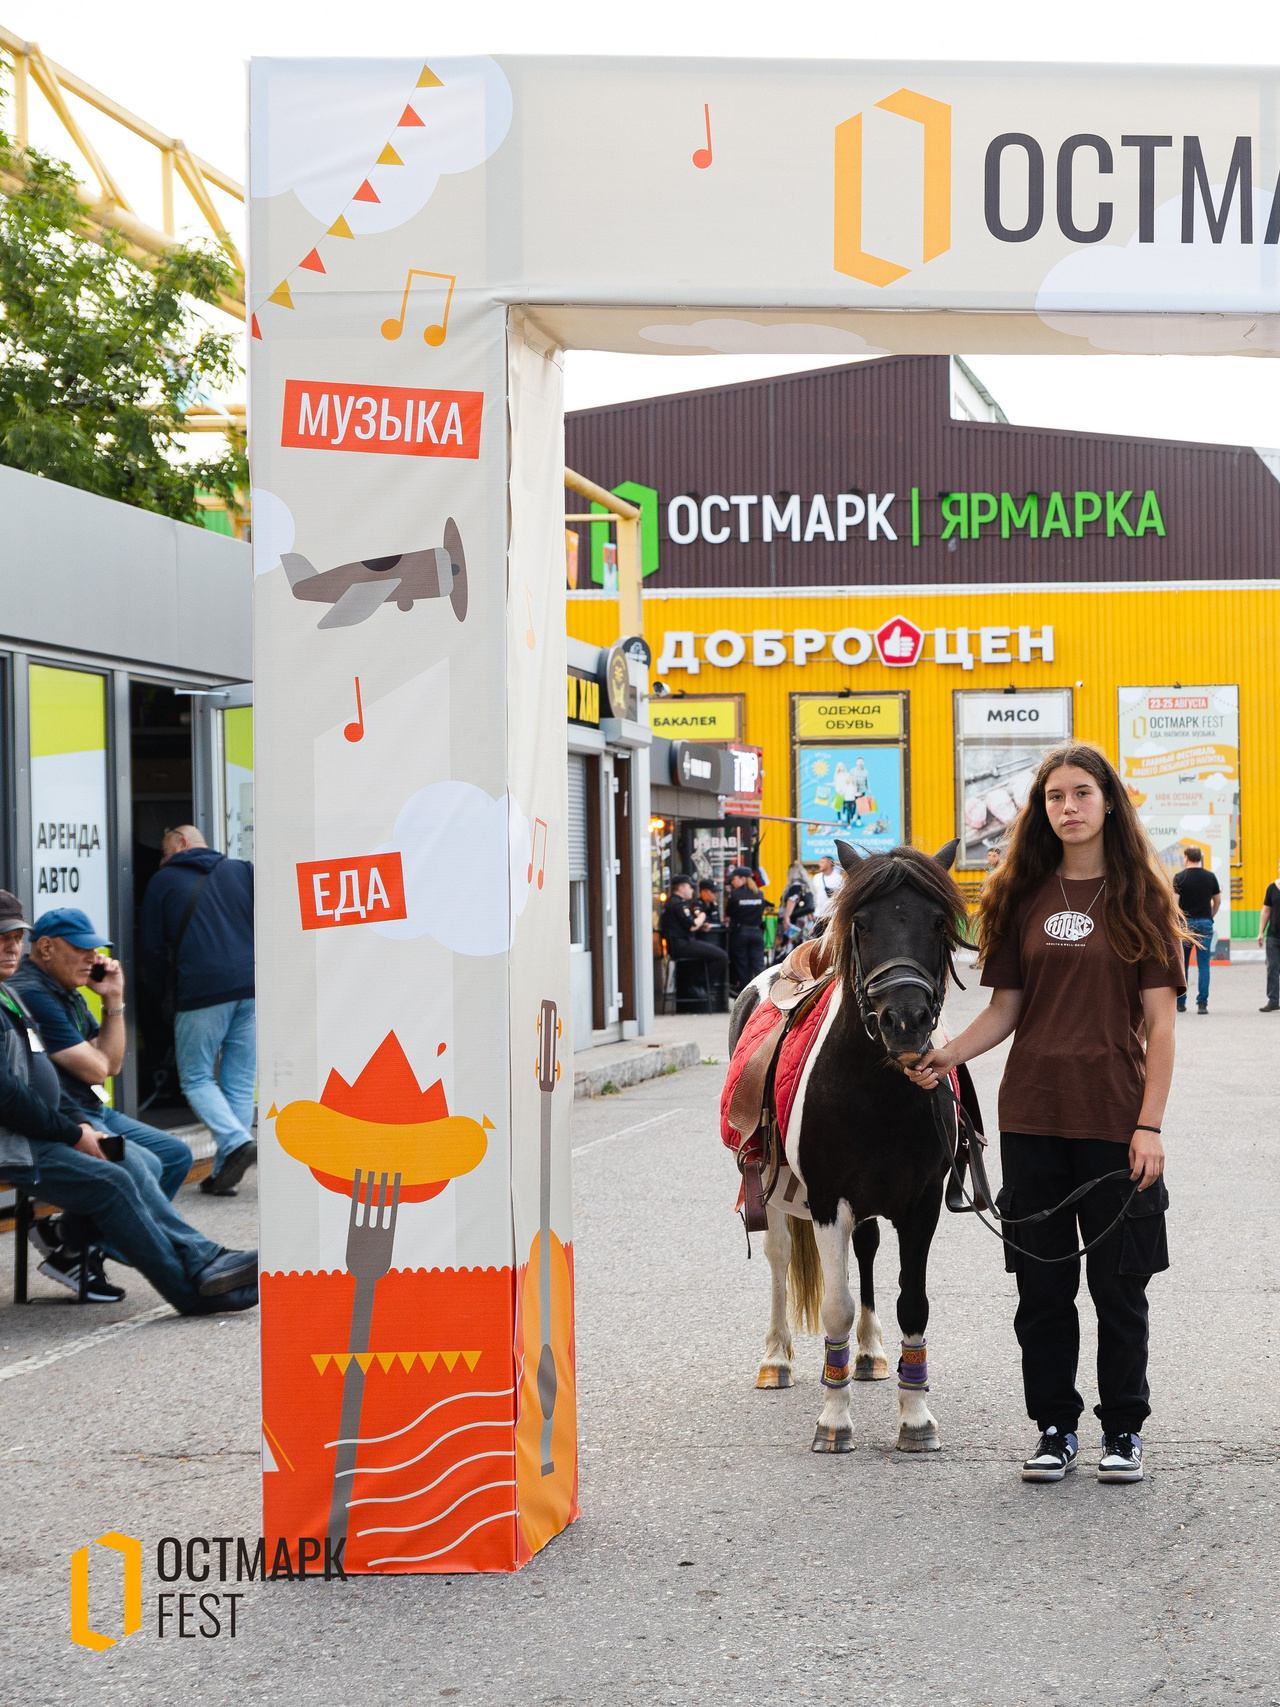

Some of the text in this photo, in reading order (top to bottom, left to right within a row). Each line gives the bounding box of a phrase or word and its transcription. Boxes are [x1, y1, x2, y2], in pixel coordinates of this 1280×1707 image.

[298, 392, 464, 446] МУЗЫКА
[667, 490, 1167, 545] ОСТМАРК ЯРМАРКА
[818, 705, 881, 716] ОДЕЖДА
[1150, 698, 1207, 709] 23-25 АВГУСТА
[653, 716, 717, 727] БАКАЛЕЯ
[825, 719, 874, 730] ОБУВЬ
[987, 709, 1039, 722] МЯСО
[1150, 715, 1225, 729] ОСТМАРК FEST
[36, 822, 101, 858] АРЕНДА
[38, 866, 81, 895] АВТО
[311, 867, 391, 922] ЕДА
[1047, 914, 1092, 938] FUTURE
